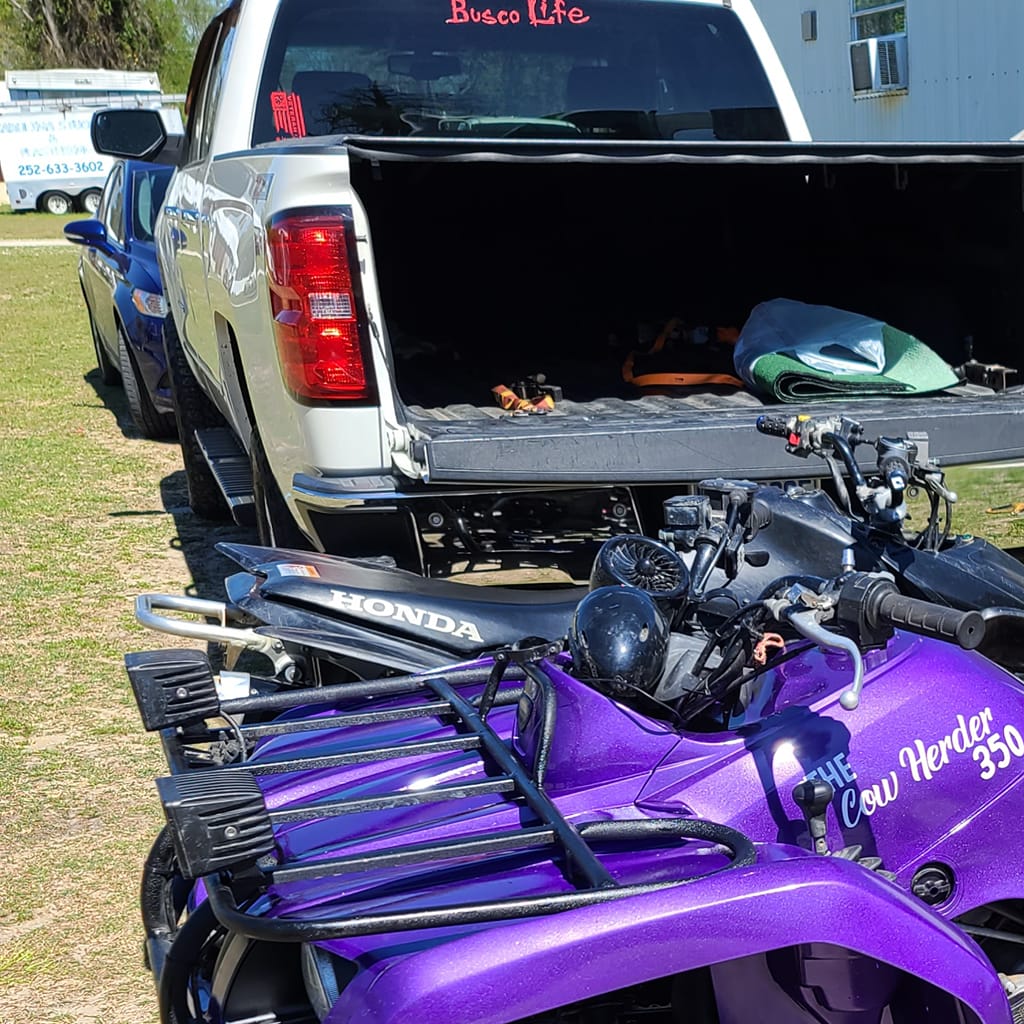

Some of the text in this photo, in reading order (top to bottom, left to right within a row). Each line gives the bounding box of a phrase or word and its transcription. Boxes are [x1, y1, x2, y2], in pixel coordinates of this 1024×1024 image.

[445, 0, 590, 27] Busco Life
[18, 161, 104, 176] 252-633-3602
[328, 589, 484, 643] HONDA
[841, 707, 993, 828] Cow Herder
[972, 724, 1024, 780] 350
